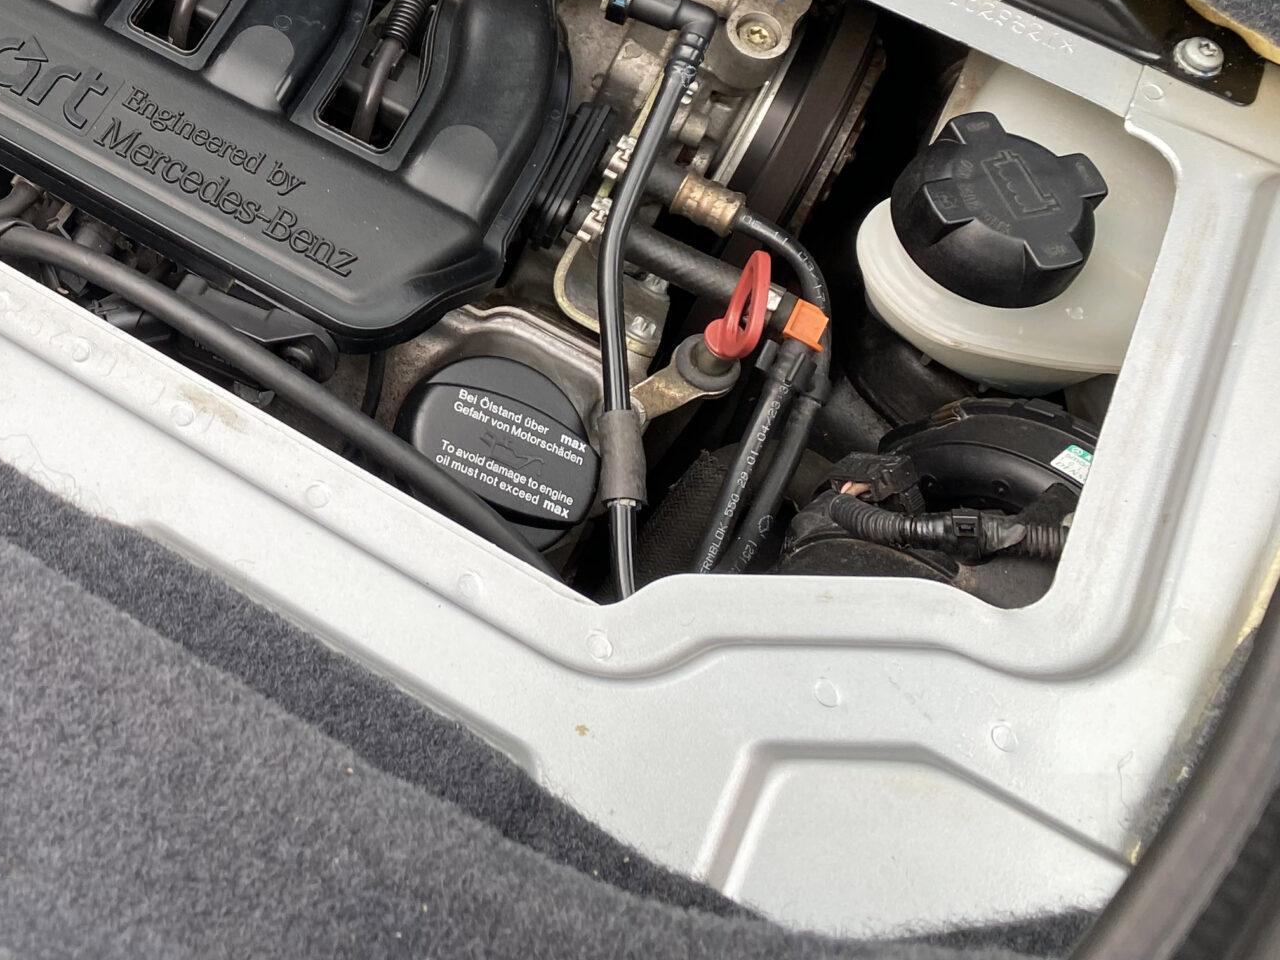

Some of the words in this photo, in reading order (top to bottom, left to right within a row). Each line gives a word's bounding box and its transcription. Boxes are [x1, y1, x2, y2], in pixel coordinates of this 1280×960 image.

[121, 85, 266, 176] Engineered
[267, 160, 306, 196] by
[93, 117, 359, 278] Mercedes-Benz
[453, 401, 490, 424] Gefahr
[491, 419, 510, 433] von
[511, 425, 584, 466] Motorschäden
[458, 388, 478, 405] Bei
[480, 396, 523, 424] Ölstand
[524, 417, 550, 435] über
[560, 433, 587, 453] max
[435, 454, 450, 466] oil
[451, 461, 479, 479] must
[479, 472, 499, 487] not
[499, 480, 540, 505] exceed
[542, 499, 570, 519] max
[441, 439, 455, 454] To
[455, 447, 488, 466] avoid
[486, 459, 527, 485] damage
[527, 476, 539, 490] to
[539, 484, 574, 506] engine
[723, 491, 741, 518] 550
